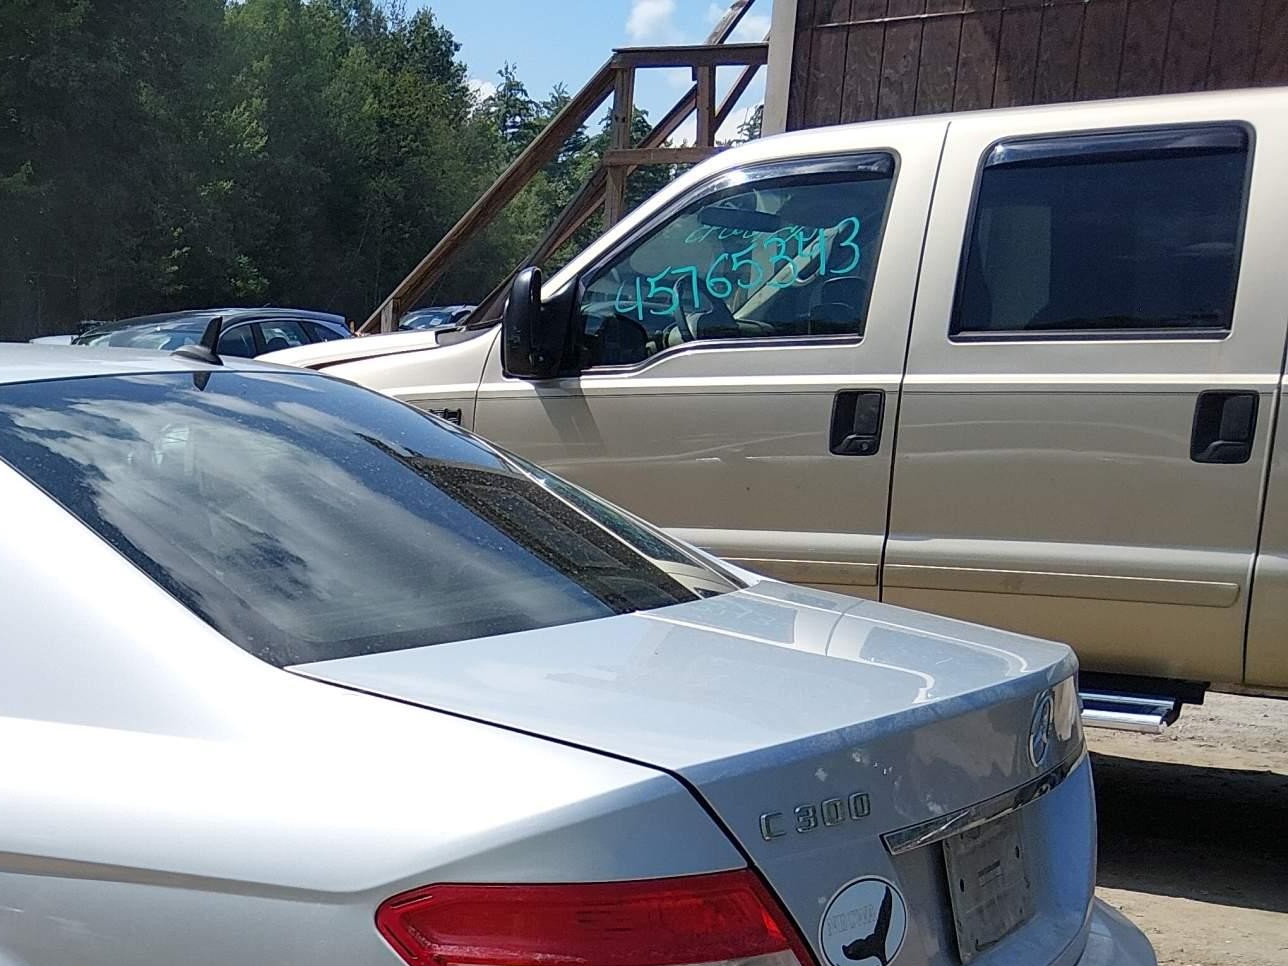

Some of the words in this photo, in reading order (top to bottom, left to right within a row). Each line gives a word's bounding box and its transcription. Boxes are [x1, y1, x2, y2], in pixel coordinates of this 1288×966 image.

[615, 216, 860, 321] 45765343
[759, 811, 787, 842] C
[793, 791, 872, 834] 300
